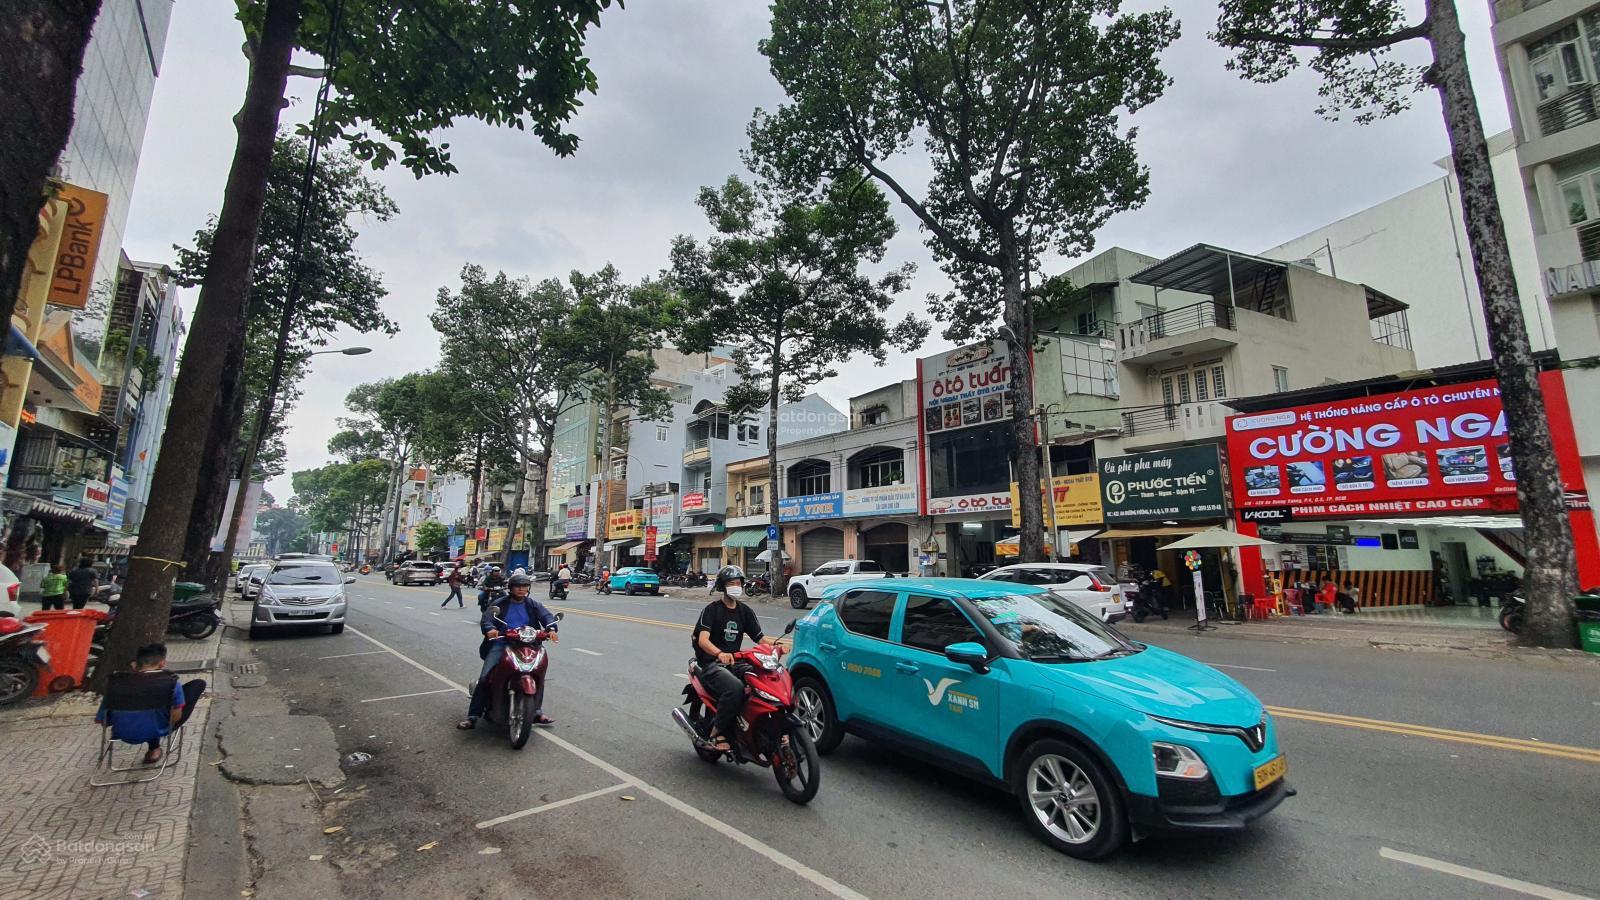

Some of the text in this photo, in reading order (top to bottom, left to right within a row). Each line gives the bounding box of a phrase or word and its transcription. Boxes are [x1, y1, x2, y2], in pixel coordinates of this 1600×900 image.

[54, 217, 94, 295] LPBank
[1300, 412, 1312, 421] HỆ
[1314, 406, 1349, 419] THỐNG
[1351, 403, 1382, 414] NÂNG
[1384, 397, 1408, 410] CẤP
[1410, 397, 1421, 407] Ô
[1424, 395, 1440, 405] TÔ
[1442, 387, 1491, 403] CHUYÊN
[1249, 409, 1509, 460] CƯỜNG NGA
[1134, 457, 1151, 473] pha
[1152, 457, 1172, 469] máy
[1127, 472, 1207, 491] PHƯỚC TIẾN
[1291, 505, 1326, 514] PHIM
[1368, 501, 1412, 512] NHIỆT
[1415, 500, 1447, 509] CAO
[770, 529, 776, 537] P
[947, 693, 968, 707] XANH
[968, 698, 979, 710] SM
